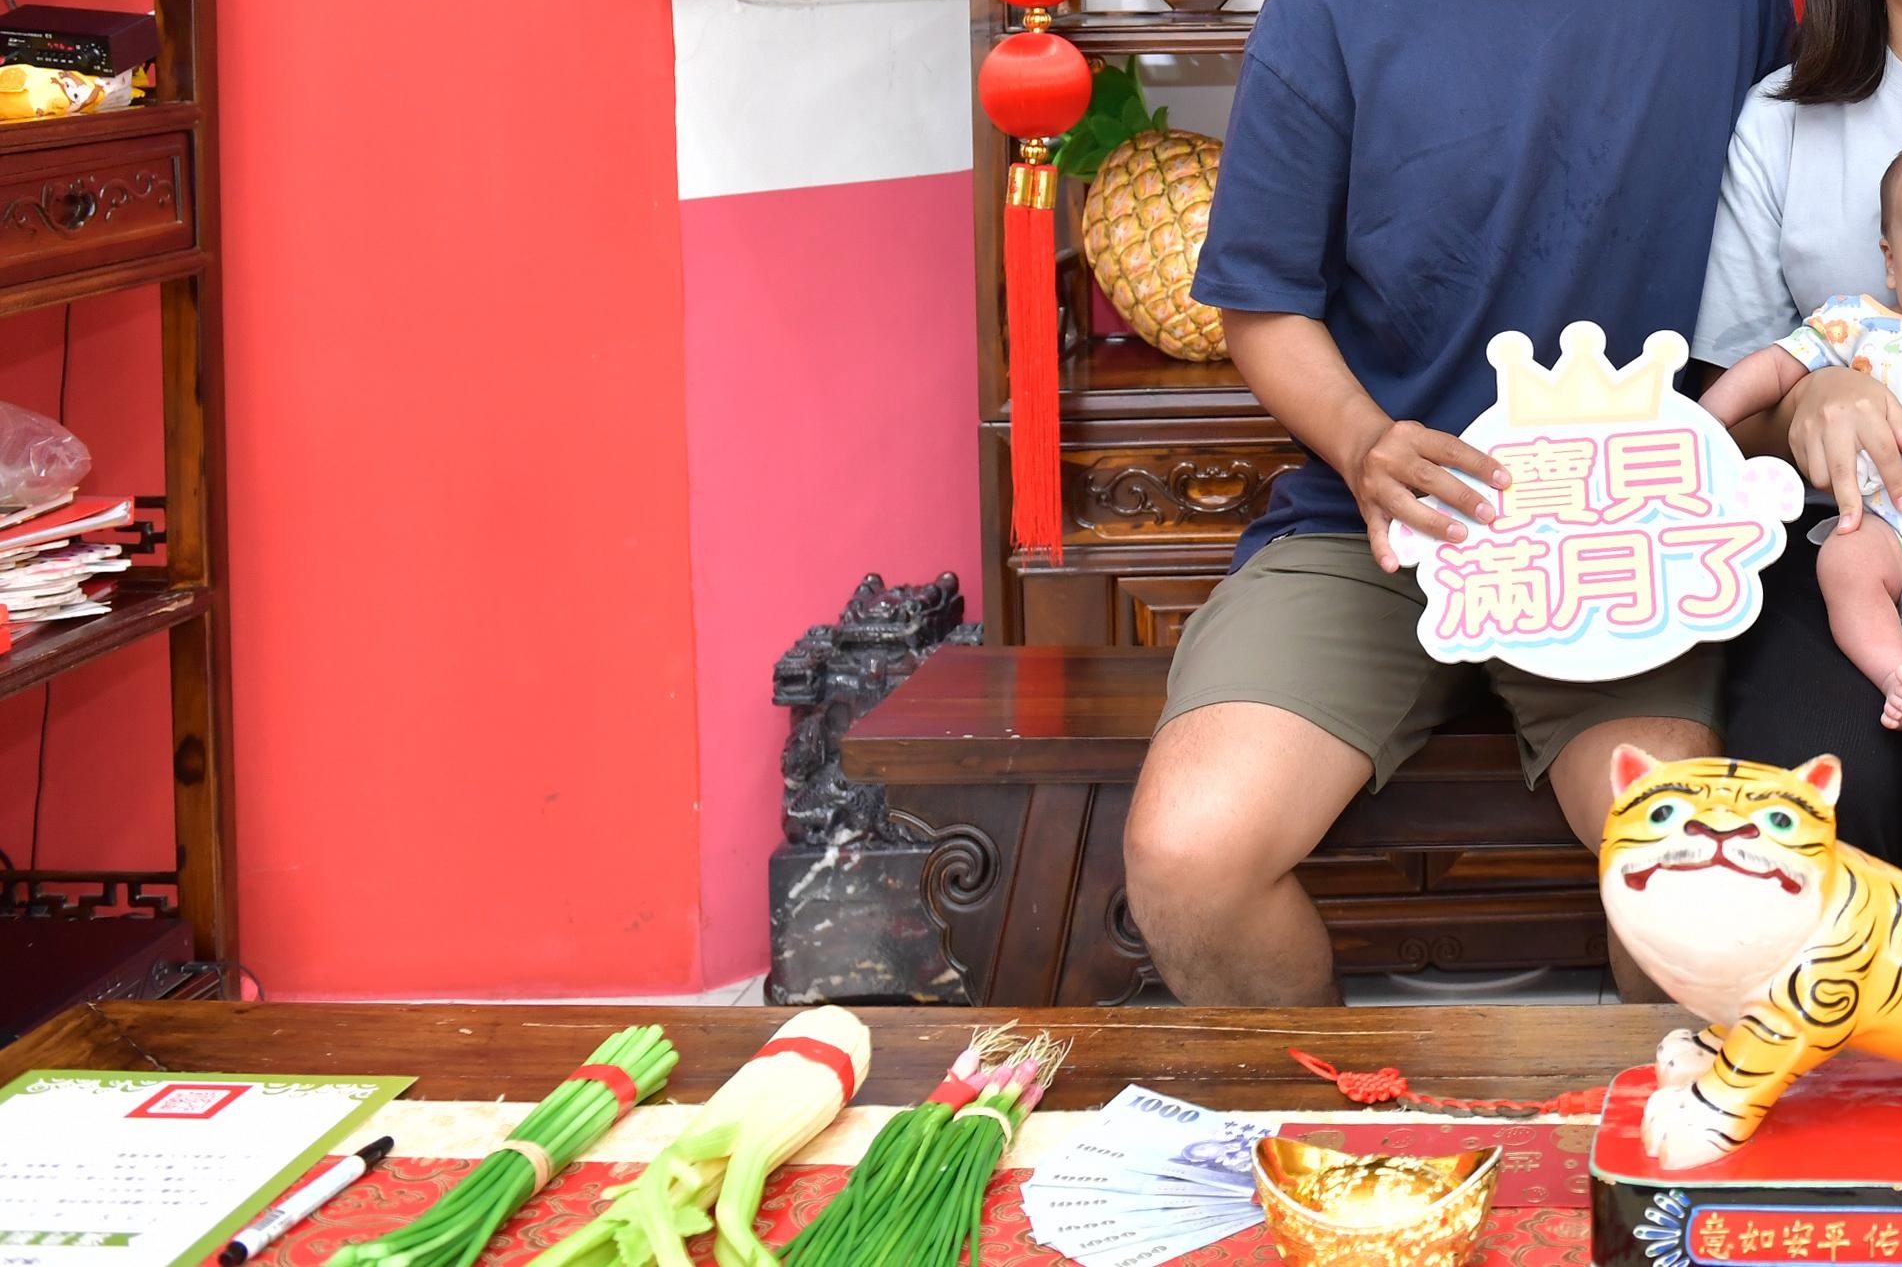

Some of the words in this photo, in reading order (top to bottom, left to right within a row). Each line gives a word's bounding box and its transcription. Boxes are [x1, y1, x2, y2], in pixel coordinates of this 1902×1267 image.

[1488, 428, 1712, 532] 寶貝
[1435, 521, 1764, 640] 滿月了
[1126, 1094, 1200, 1124] 1000
